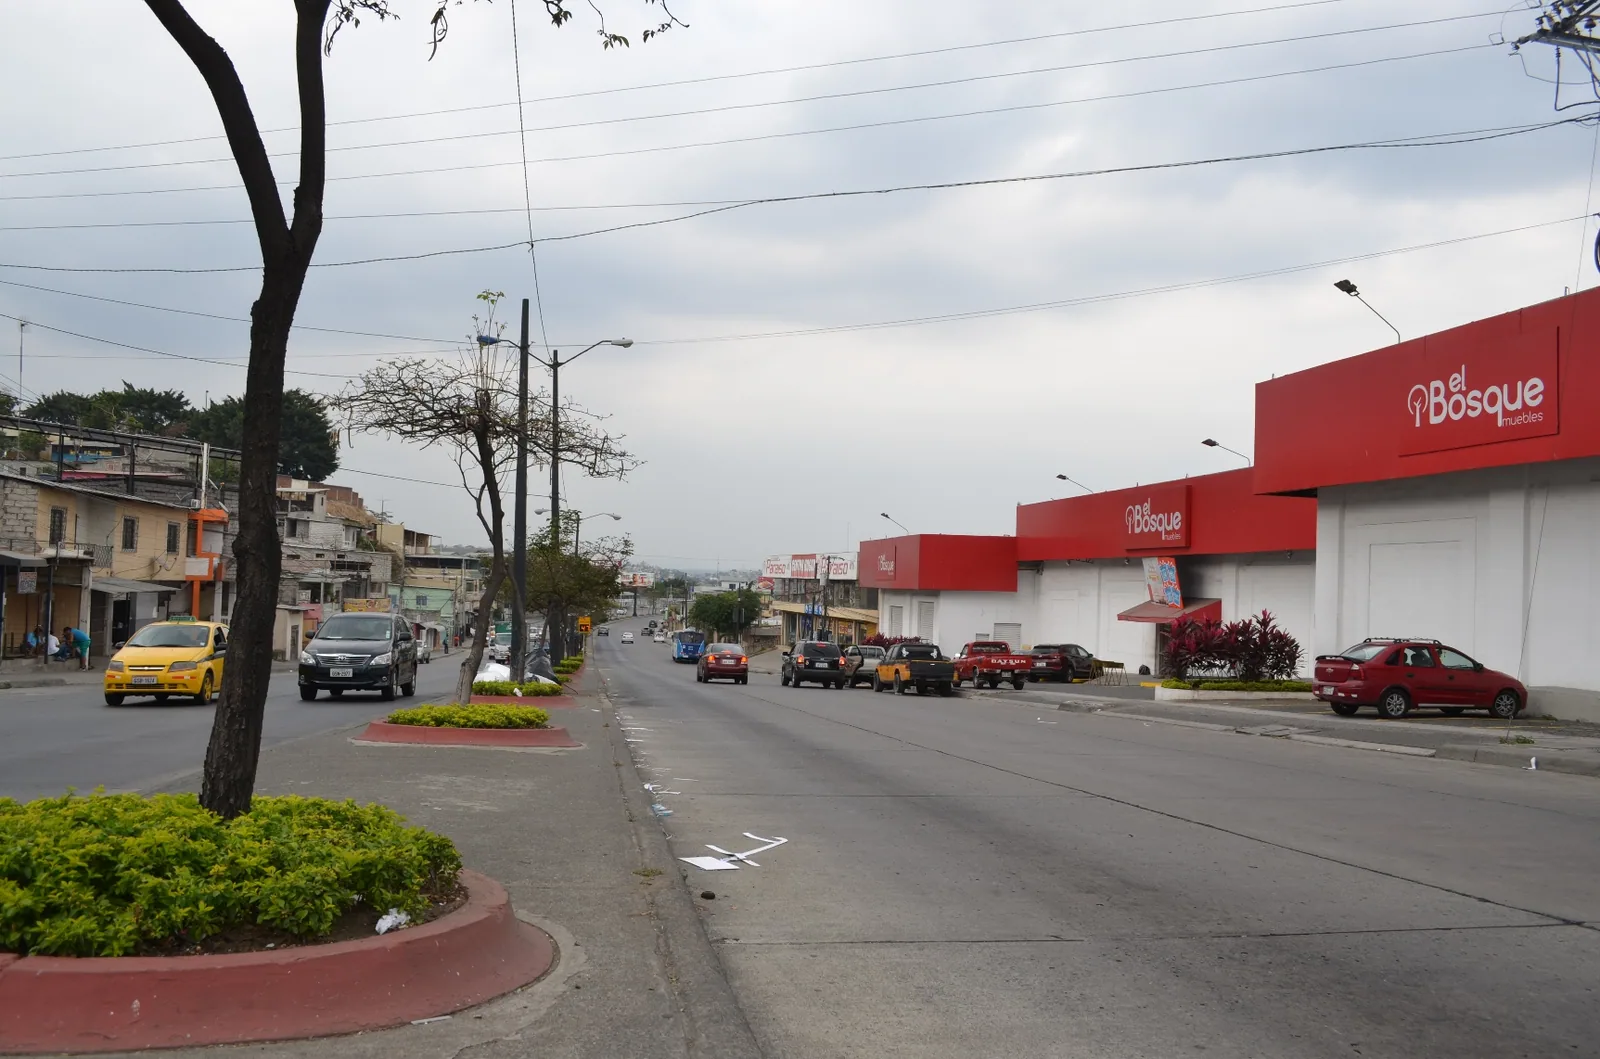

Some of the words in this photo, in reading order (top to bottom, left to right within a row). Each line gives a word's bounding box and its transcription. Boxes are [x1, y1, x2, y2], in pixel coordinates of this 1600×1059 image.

[1449, 364, 1466, 392] el
[1429, 377, 1544, 427] Bosque
[1502, 411, 1543, 427] muebles
[1143, 498, 1150, 515] el
[1135, 505, 1181, 540] Bosque
